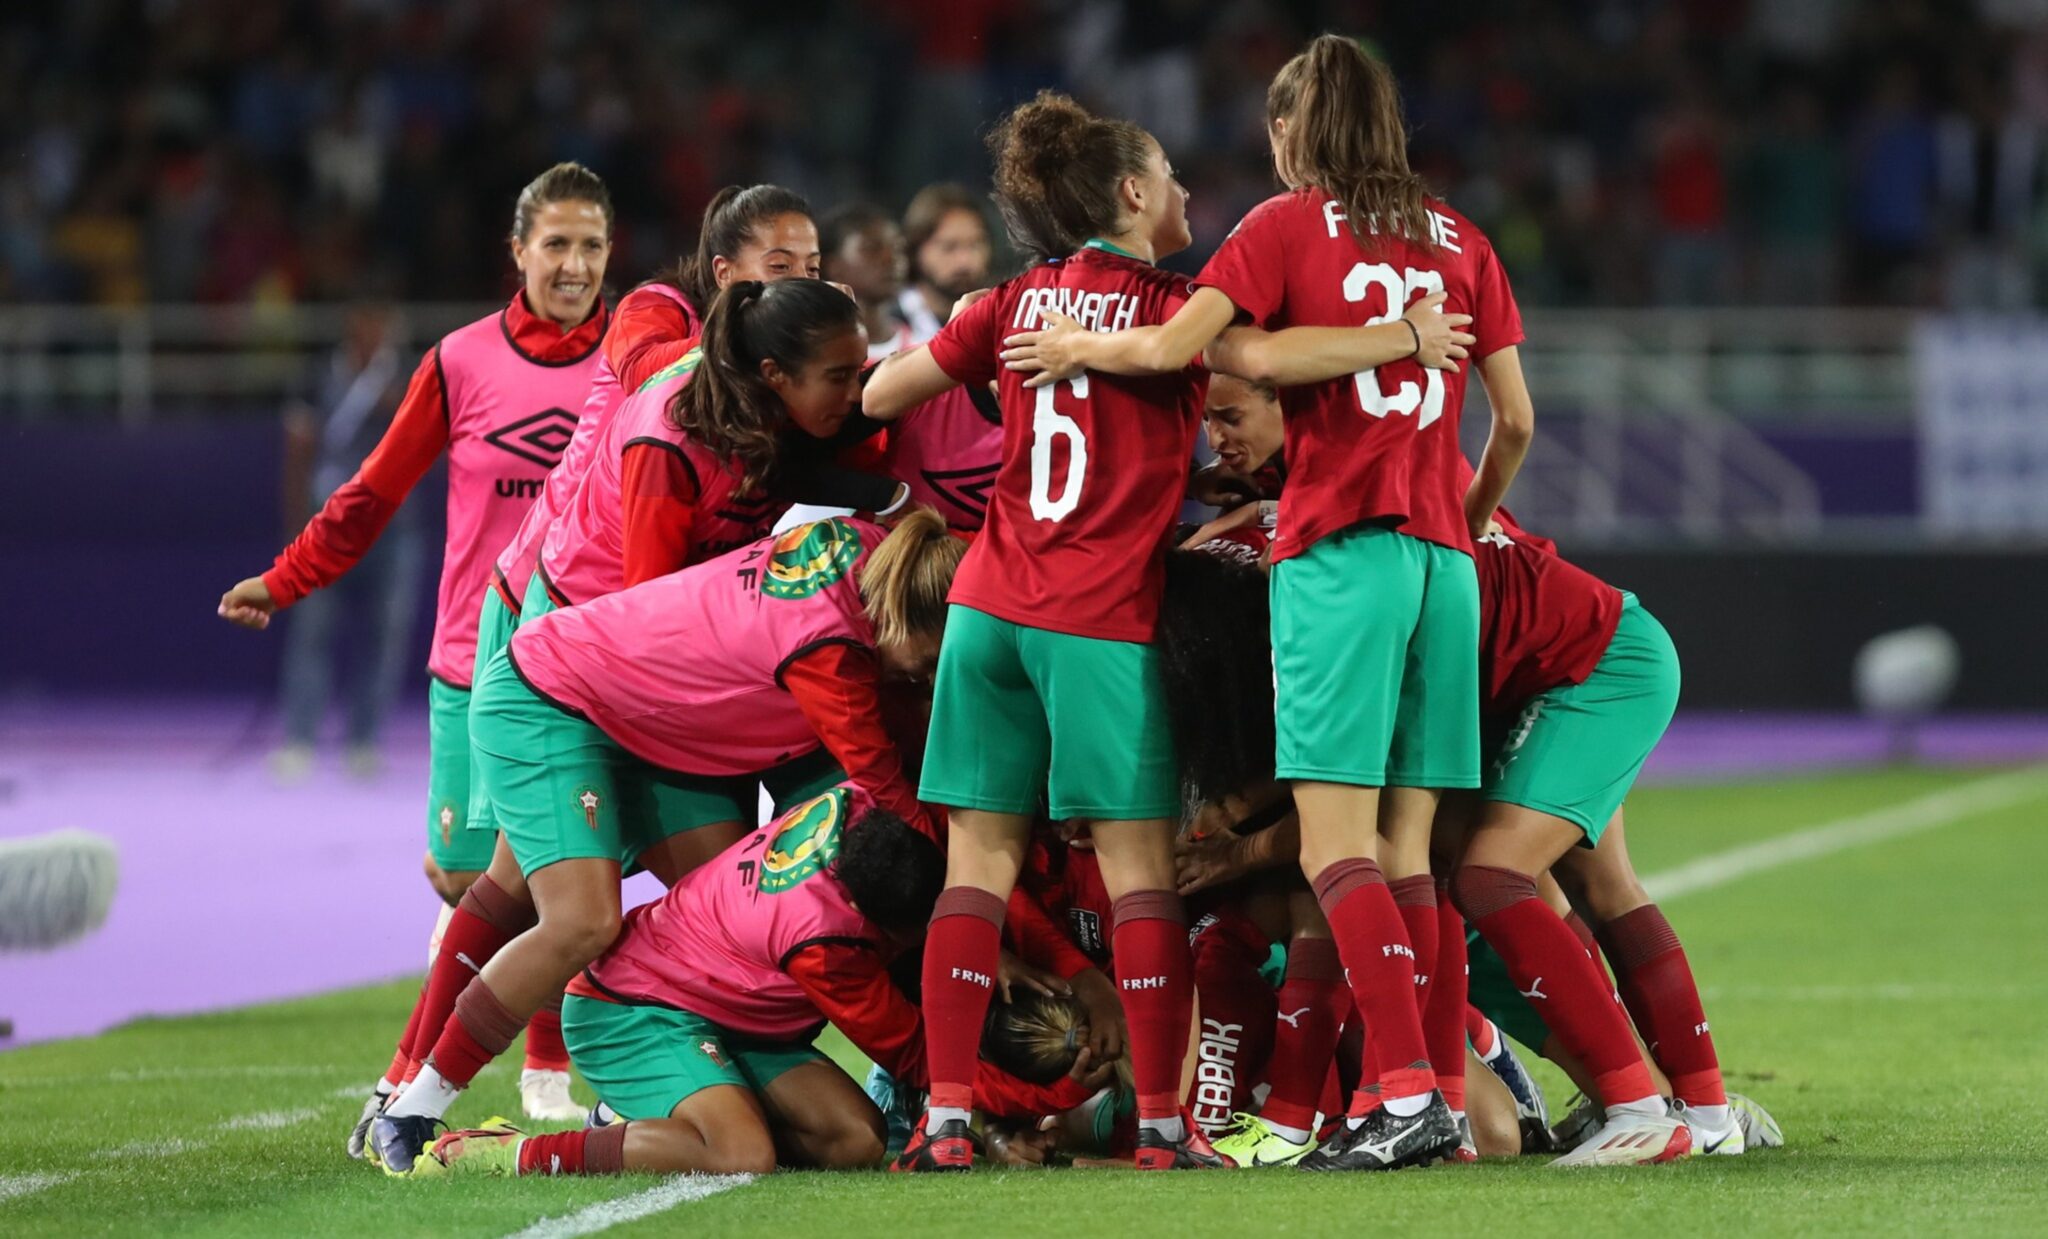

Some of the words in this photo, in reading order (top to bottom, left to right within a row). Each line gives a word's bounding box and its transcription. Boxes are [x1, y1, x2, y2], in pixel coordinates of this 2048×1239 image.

[1029, 374, 1089, 523] 6
[952, 967, 992, 989] FRMF
[1122, 976, 1168, 990] FRMF
